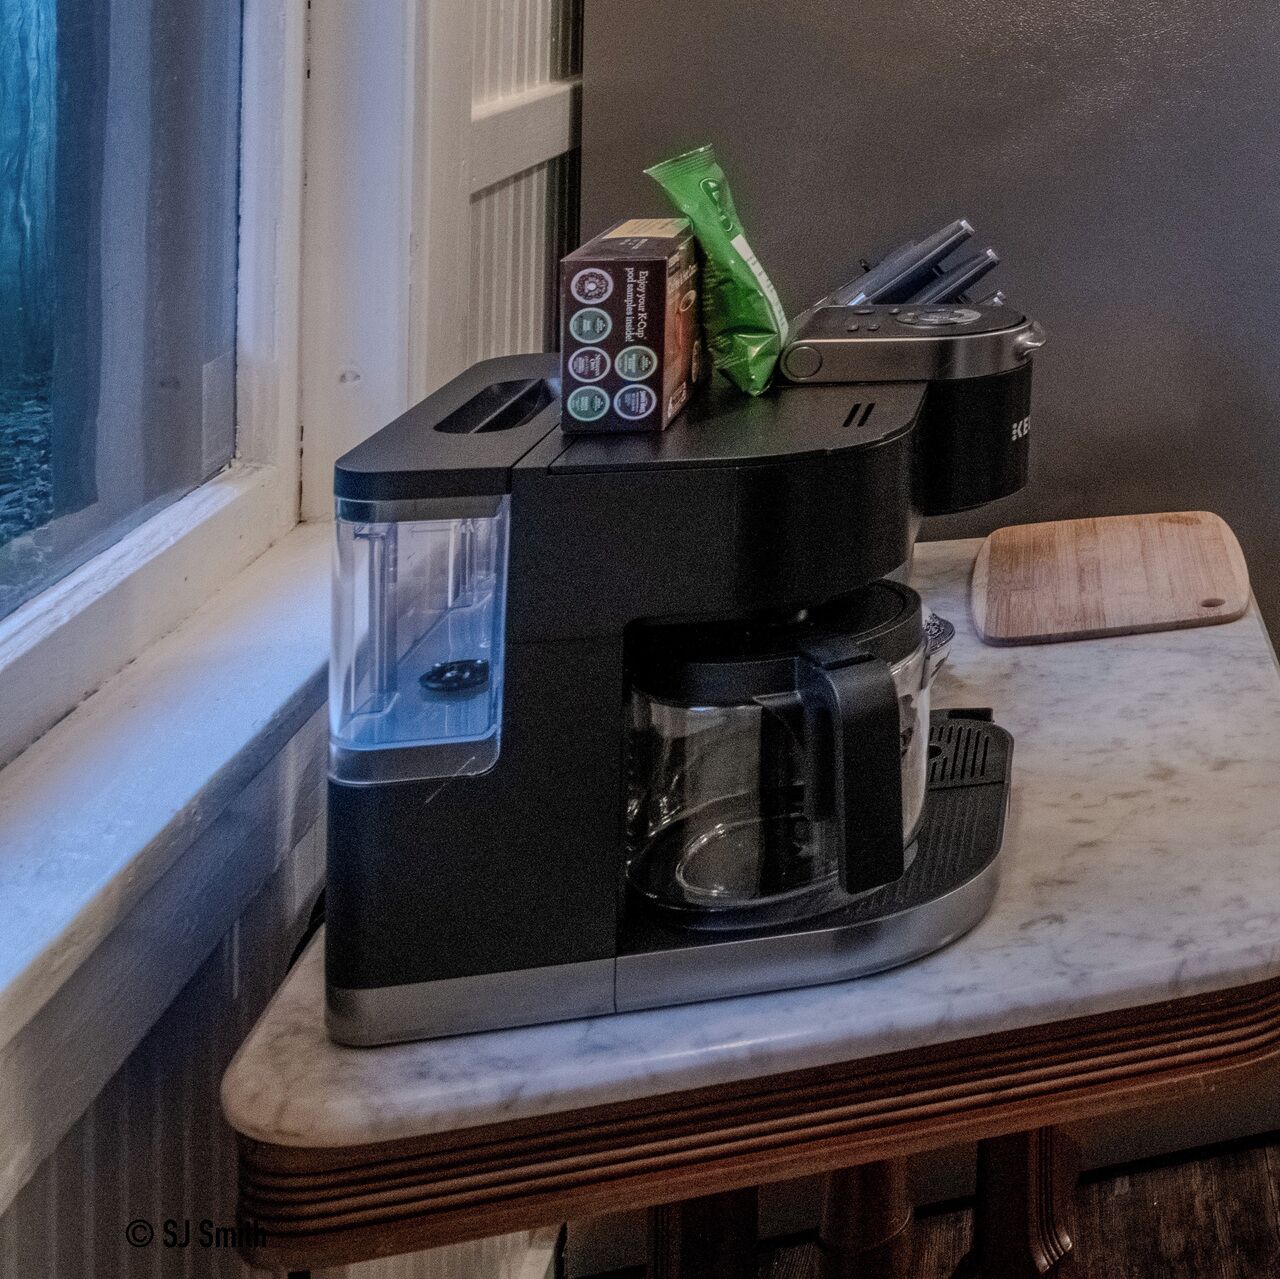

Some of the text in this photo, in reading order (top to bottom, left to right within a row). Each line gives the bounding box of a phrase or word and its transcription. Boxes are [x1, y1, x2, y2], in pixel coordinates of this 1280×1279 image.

[625, 267, 635, 283] pod
[635, 270, 649, 292] Enjoy
[624, 283, 635, 315] samples
[635, 293, 647, 312] your
[625, 316, 635, 342] inside!
